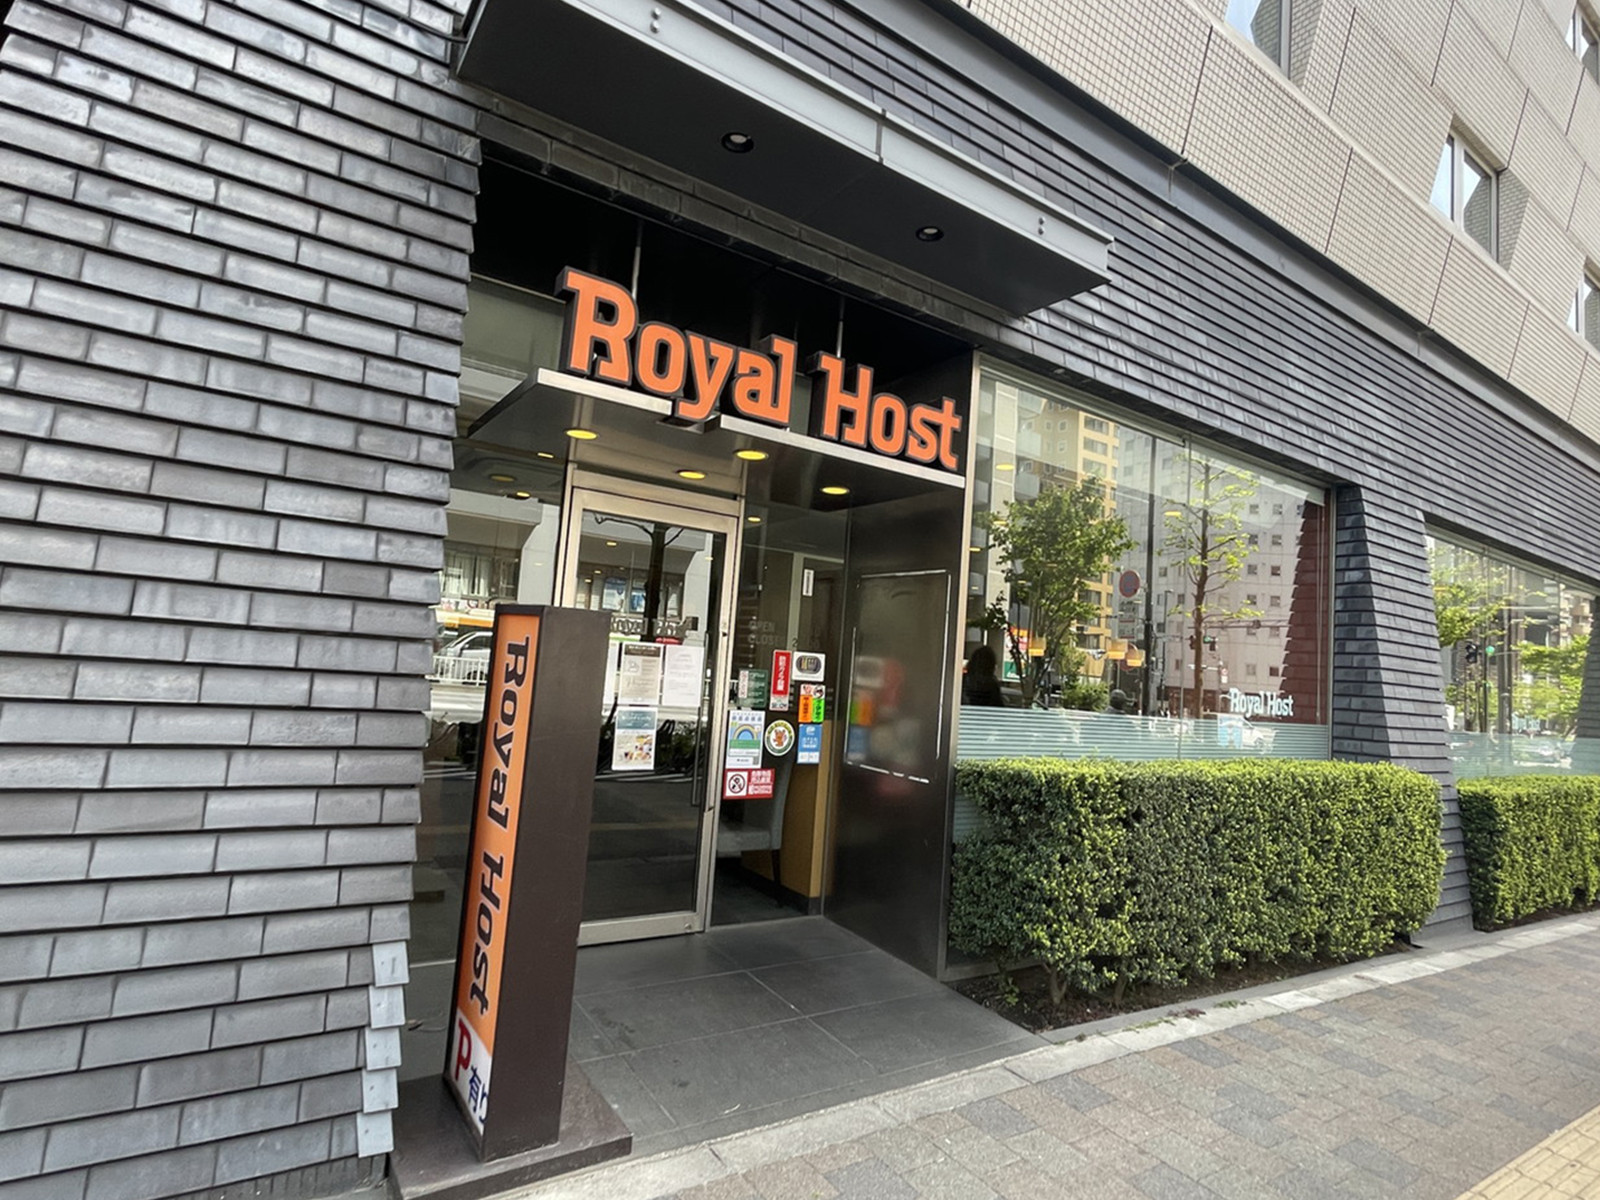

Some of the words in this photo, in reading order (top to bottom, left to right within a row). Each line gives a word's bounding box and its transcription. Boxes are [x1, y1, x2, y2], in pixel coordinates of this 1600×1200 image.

[563, 266, 798, 427] Royal
[816, 351, 962, 471] Host
[487, 636, 530, 830] Royal
[1229, 687, 1265, 718] Royal
[1266, 691, 1294, 717] Host
[469, 848, 505, 1016] Host
[454, 1018, 472, 1081] P
